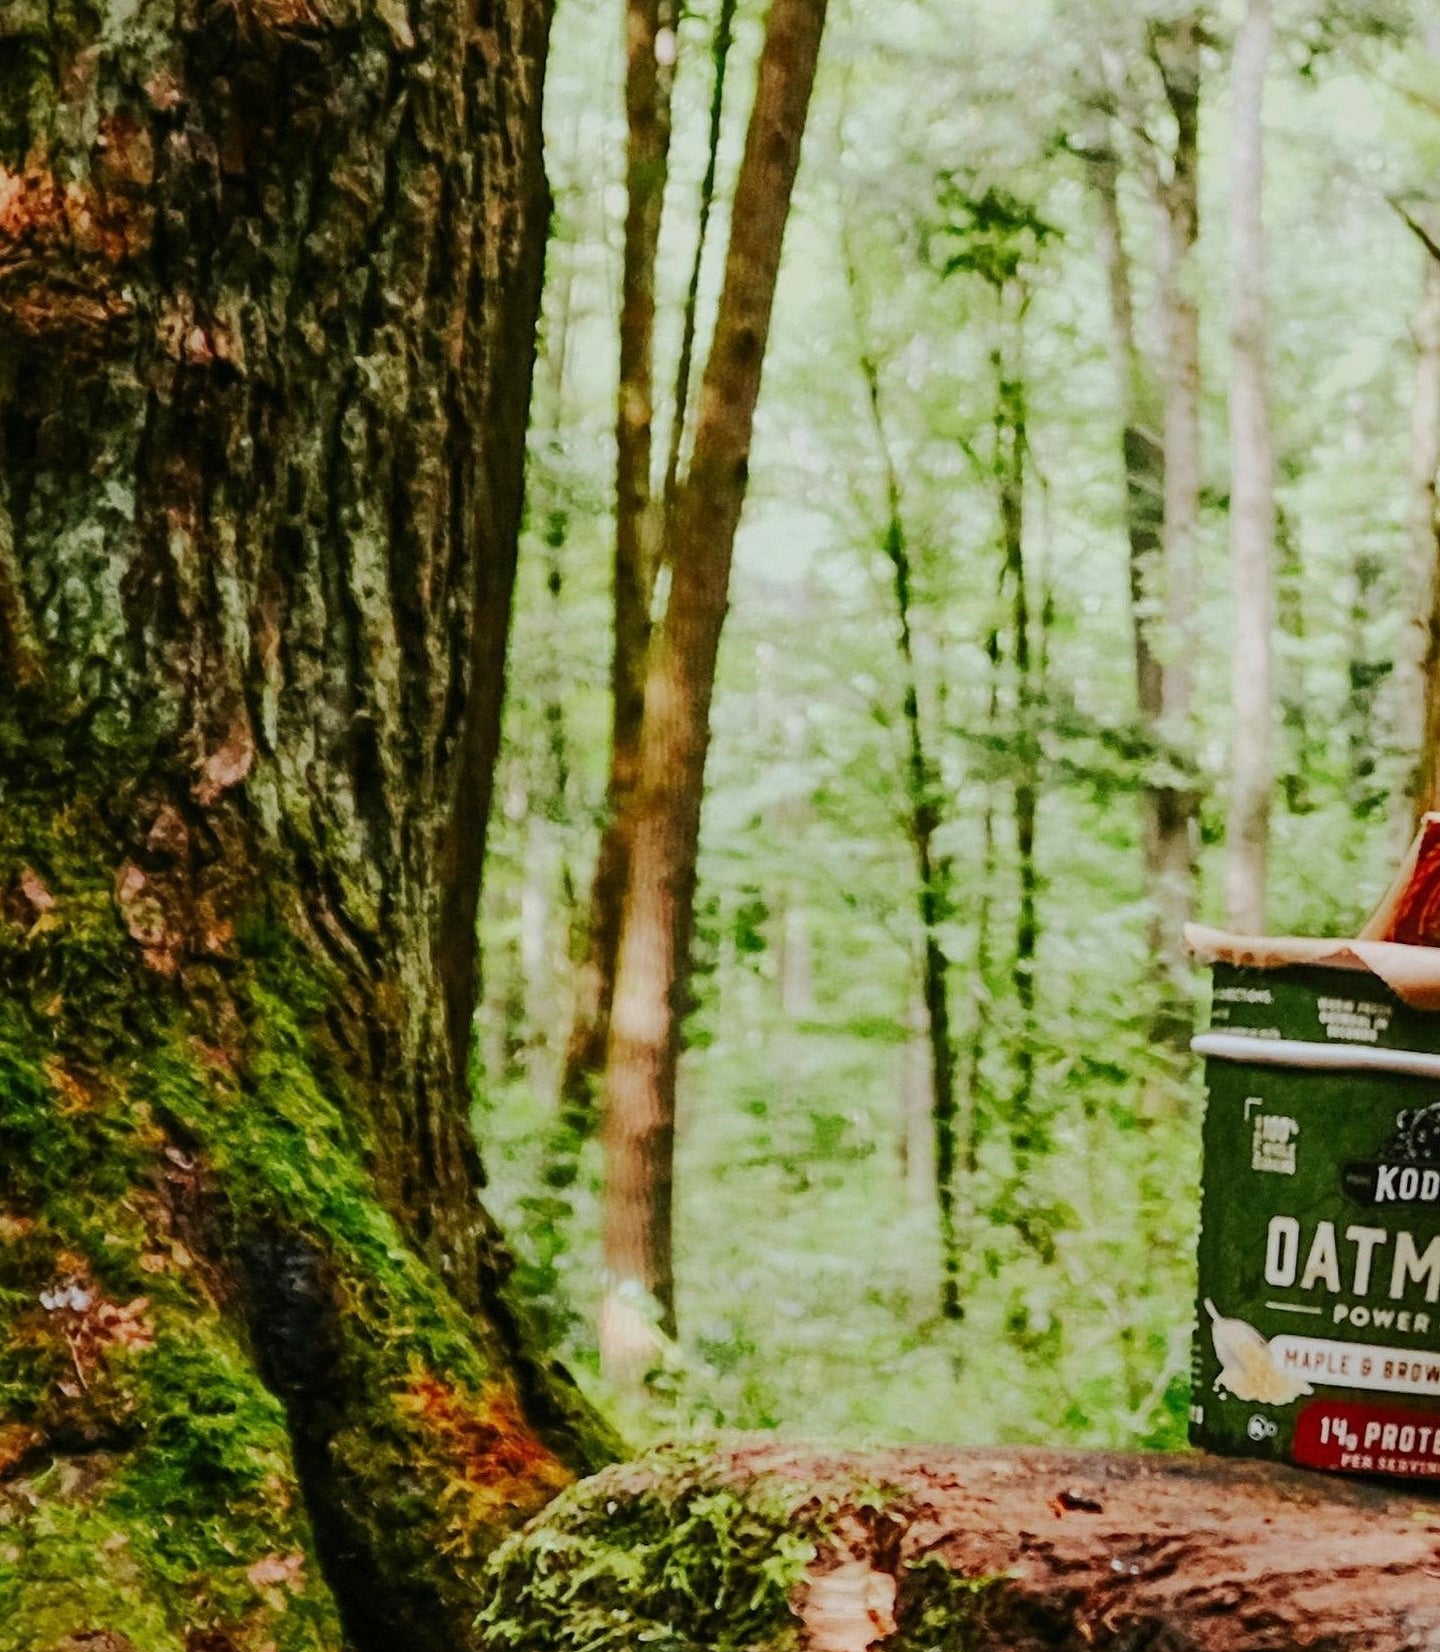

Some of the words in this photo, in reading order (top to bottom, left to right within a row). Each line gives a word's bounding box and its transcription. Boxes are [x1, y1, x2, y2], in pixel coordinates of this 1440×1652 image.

[1332, 1304, 1431, 1334] POWER
[1284, 1348, 1350, 1376] MAPLE
[1359, 1357, 1372, 1376] &
[1340, 1452, 1373, 1469] PER
